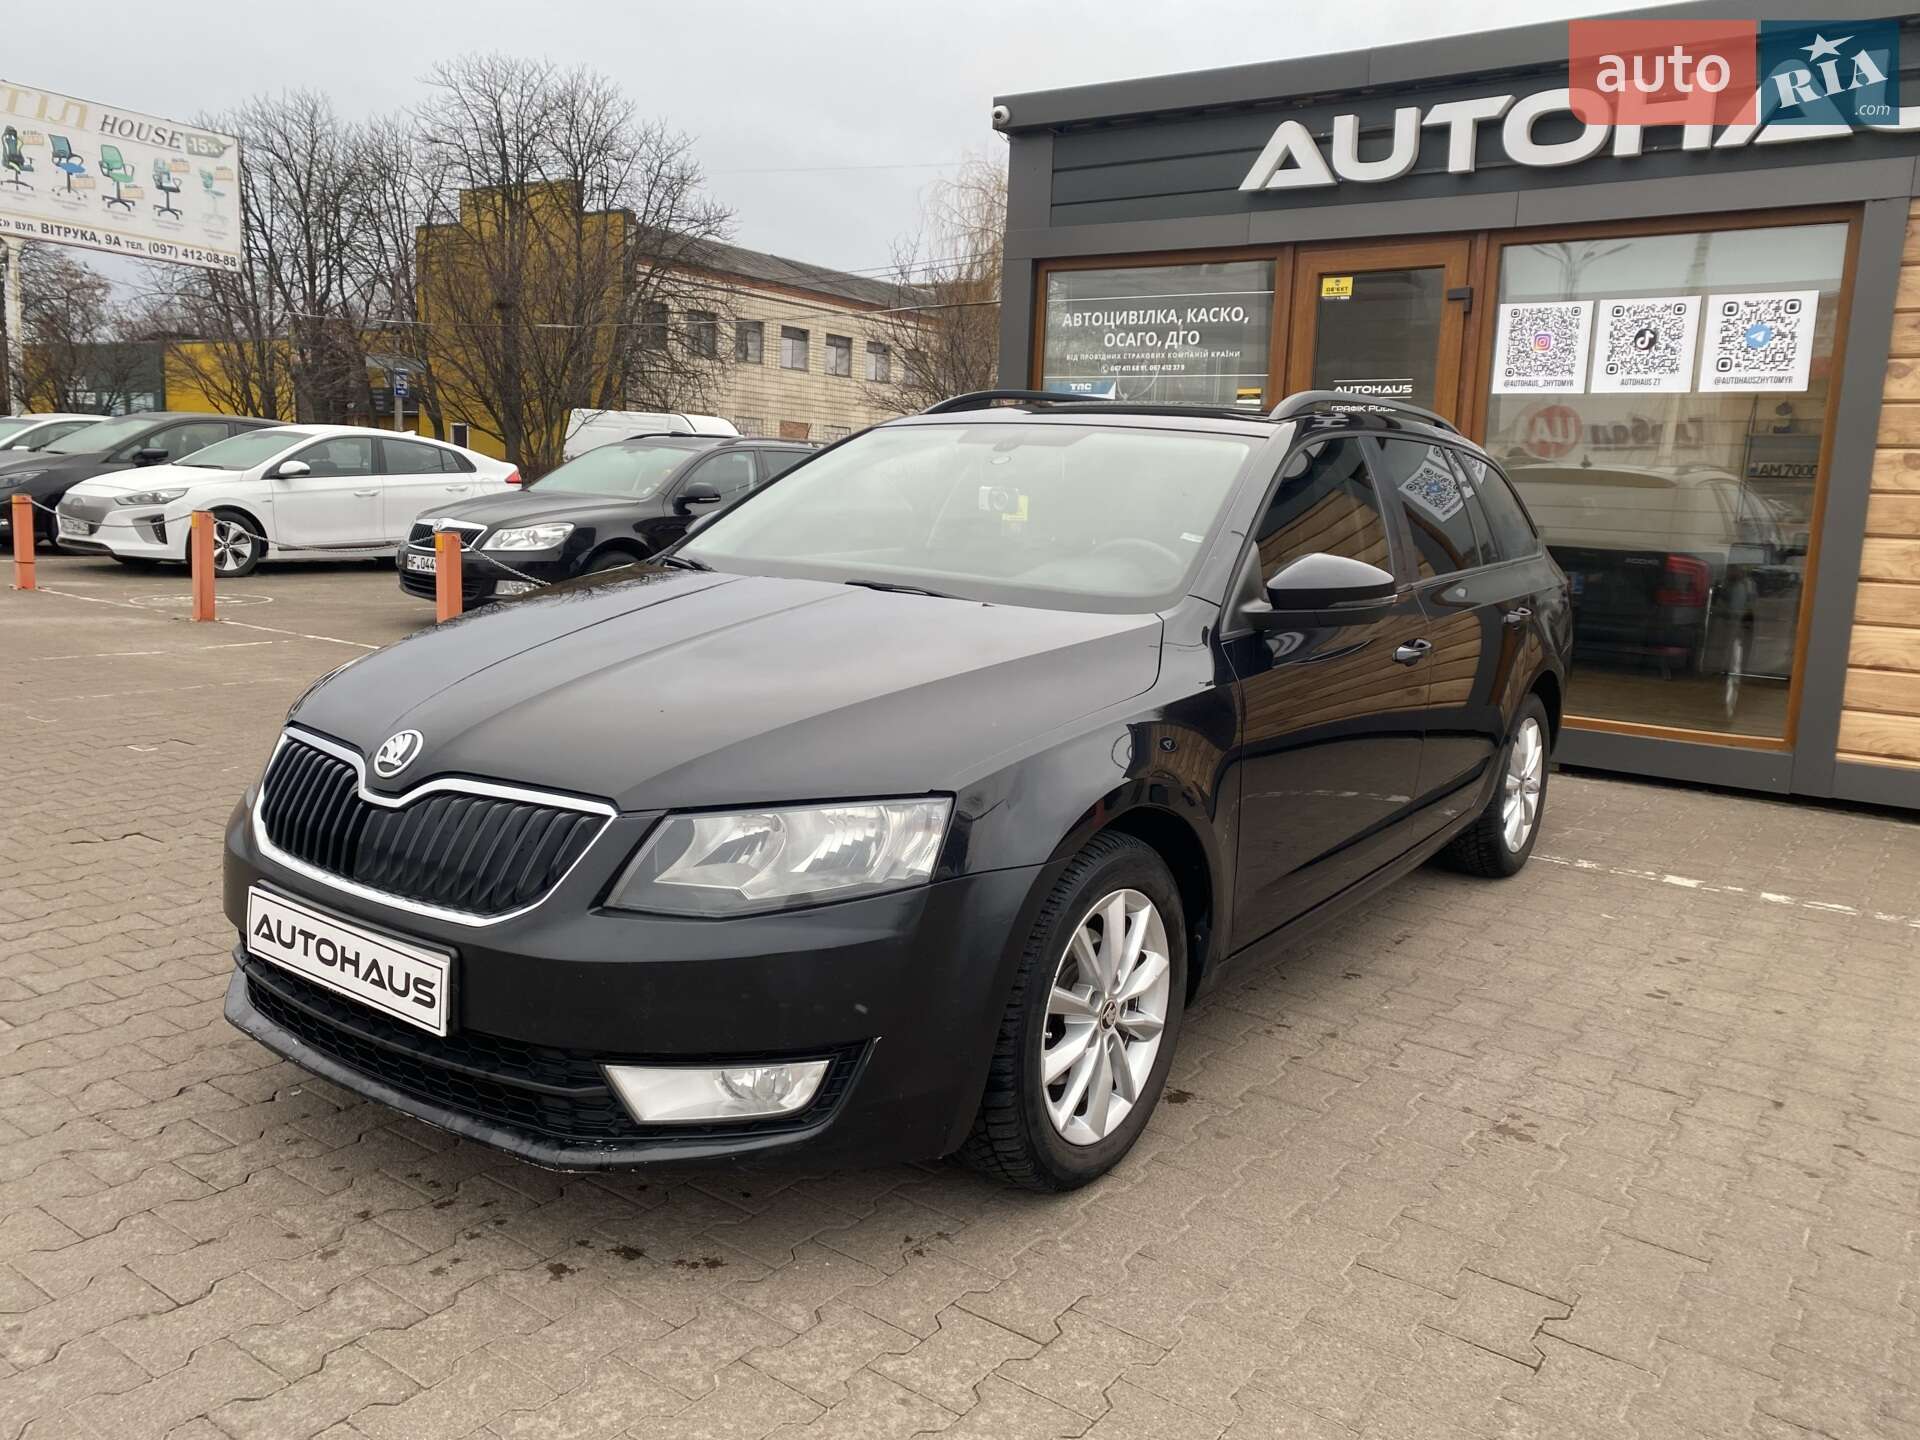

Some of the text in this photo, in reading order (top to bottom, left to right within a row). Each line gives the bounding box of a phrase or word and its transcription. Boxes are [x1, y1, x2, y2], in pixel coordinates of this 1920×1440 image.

[101, 114, 185, 149] HOUSE
[40, 222, 101, 245] ВІТРУКА,
[148, 241, 178, 259] (097)
[1062, 306, 1250, 329] АВТОЦИВІЛКА, КАСКО,
[1104, 330, 1200, 349] ОСАГО, ДГО
[1334, 384, 1413, 394] AUTOHAUS
[253, 913, 437, 1010] AUTOHAUS
